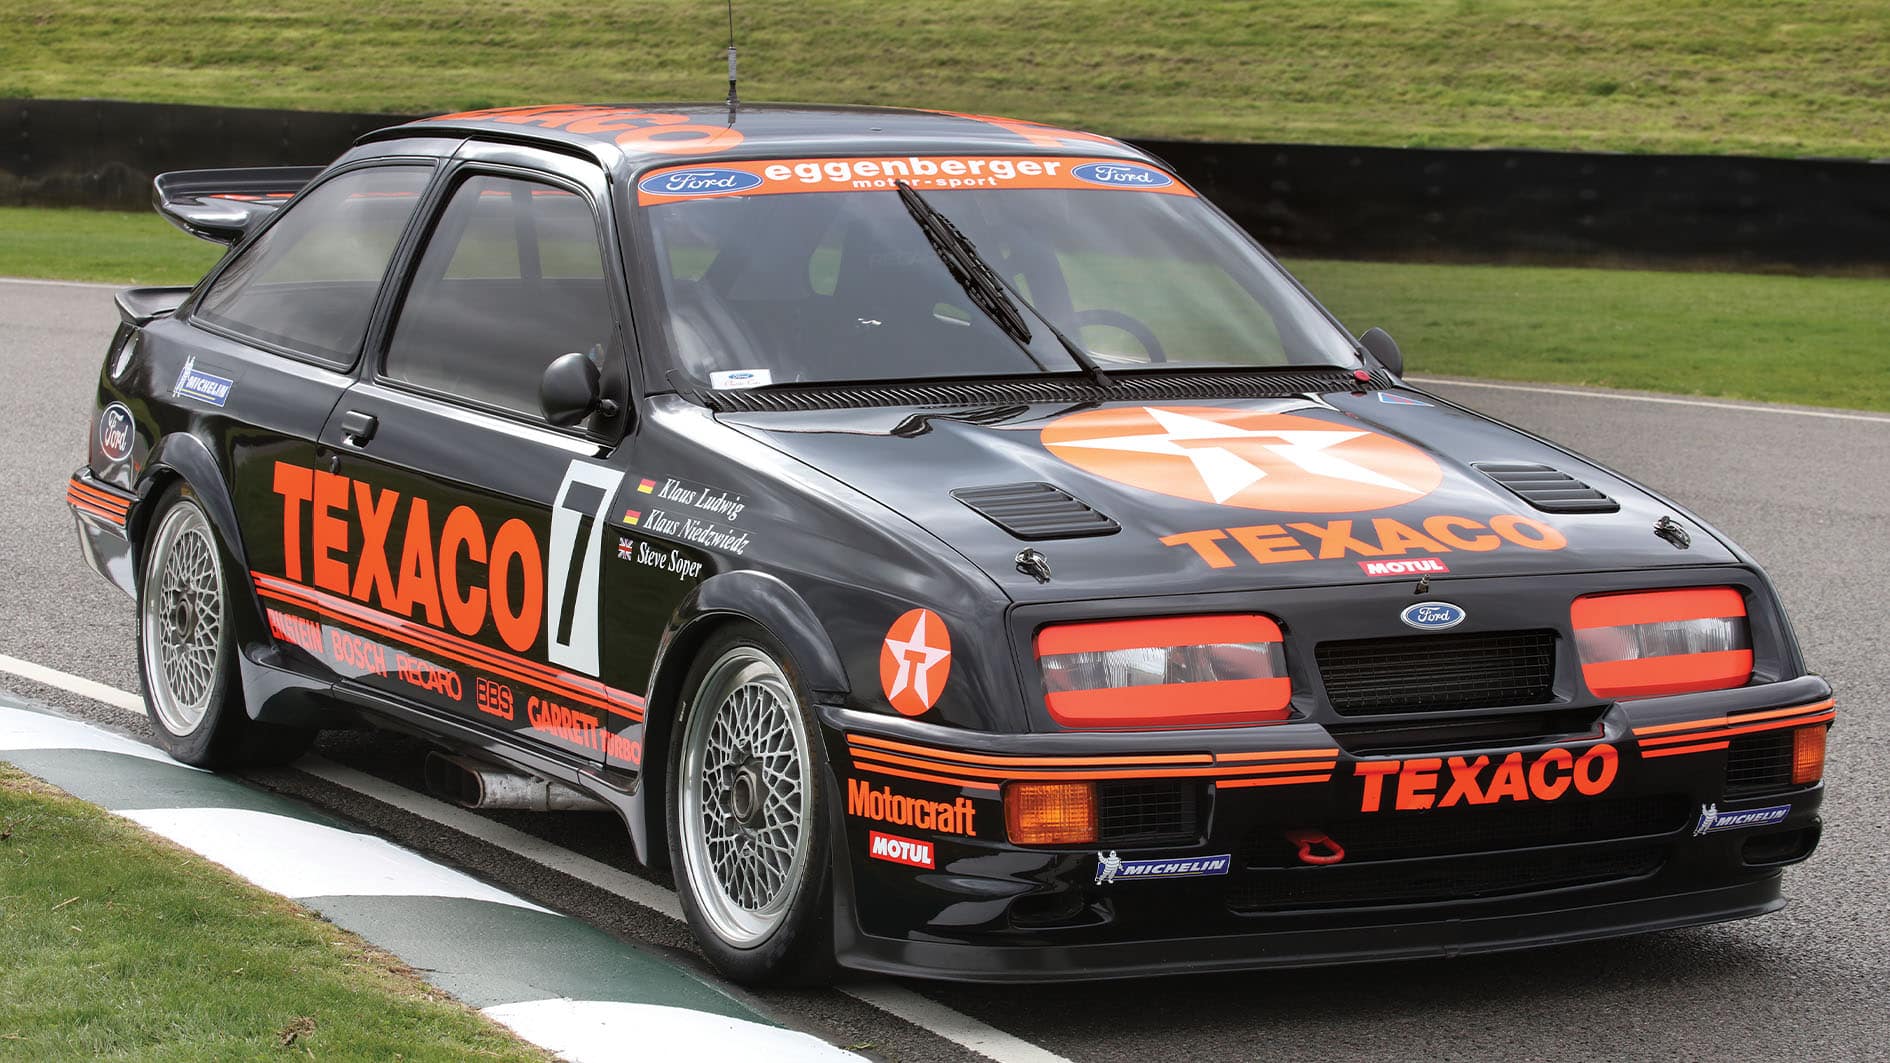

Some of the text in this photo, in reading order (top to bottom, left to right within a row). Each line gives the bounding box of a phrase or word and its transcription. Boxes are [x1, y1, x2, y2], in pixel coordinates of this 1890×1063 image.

[666, 172, 737, 191] Ford
[764, 157, 1062, 184] eggenberger
[1095, 166, 1153, 183] Ford
[186, 374, 230, 399] MICHELIN
[103, 409, 128, 452] Ford
[658, 478, 746, 521] Klaus Ludwig
[643, 508, 751, 556] Klaus Niedzwiedz
[1159, 514, 1568, 569] TEXACO
[272, 461, 544, 652] TEXACO
[554, 473, 612, 655] 7
[636, 541, 703, 581] Steve Soper
[1366, 559, 1445, 575] MOTUL
[1417, 607, 1451, 624] Ford
[332, 631, 388, 677] BOSCH
[397, 654, 463, 702] RECARO
[476, 677, 514, 721] BBS
[527, 695, 641, 765] GARRETT TURBO
[1354, 743, 1619, 813] TEXACO
[847, 778, 977, 837] Motorcraft
[1716, 809, 1788, 828] MICHELIN
[872, 835, 932, 865] MOTUL
[1123, 858, 1227, 877] MICHELIN
